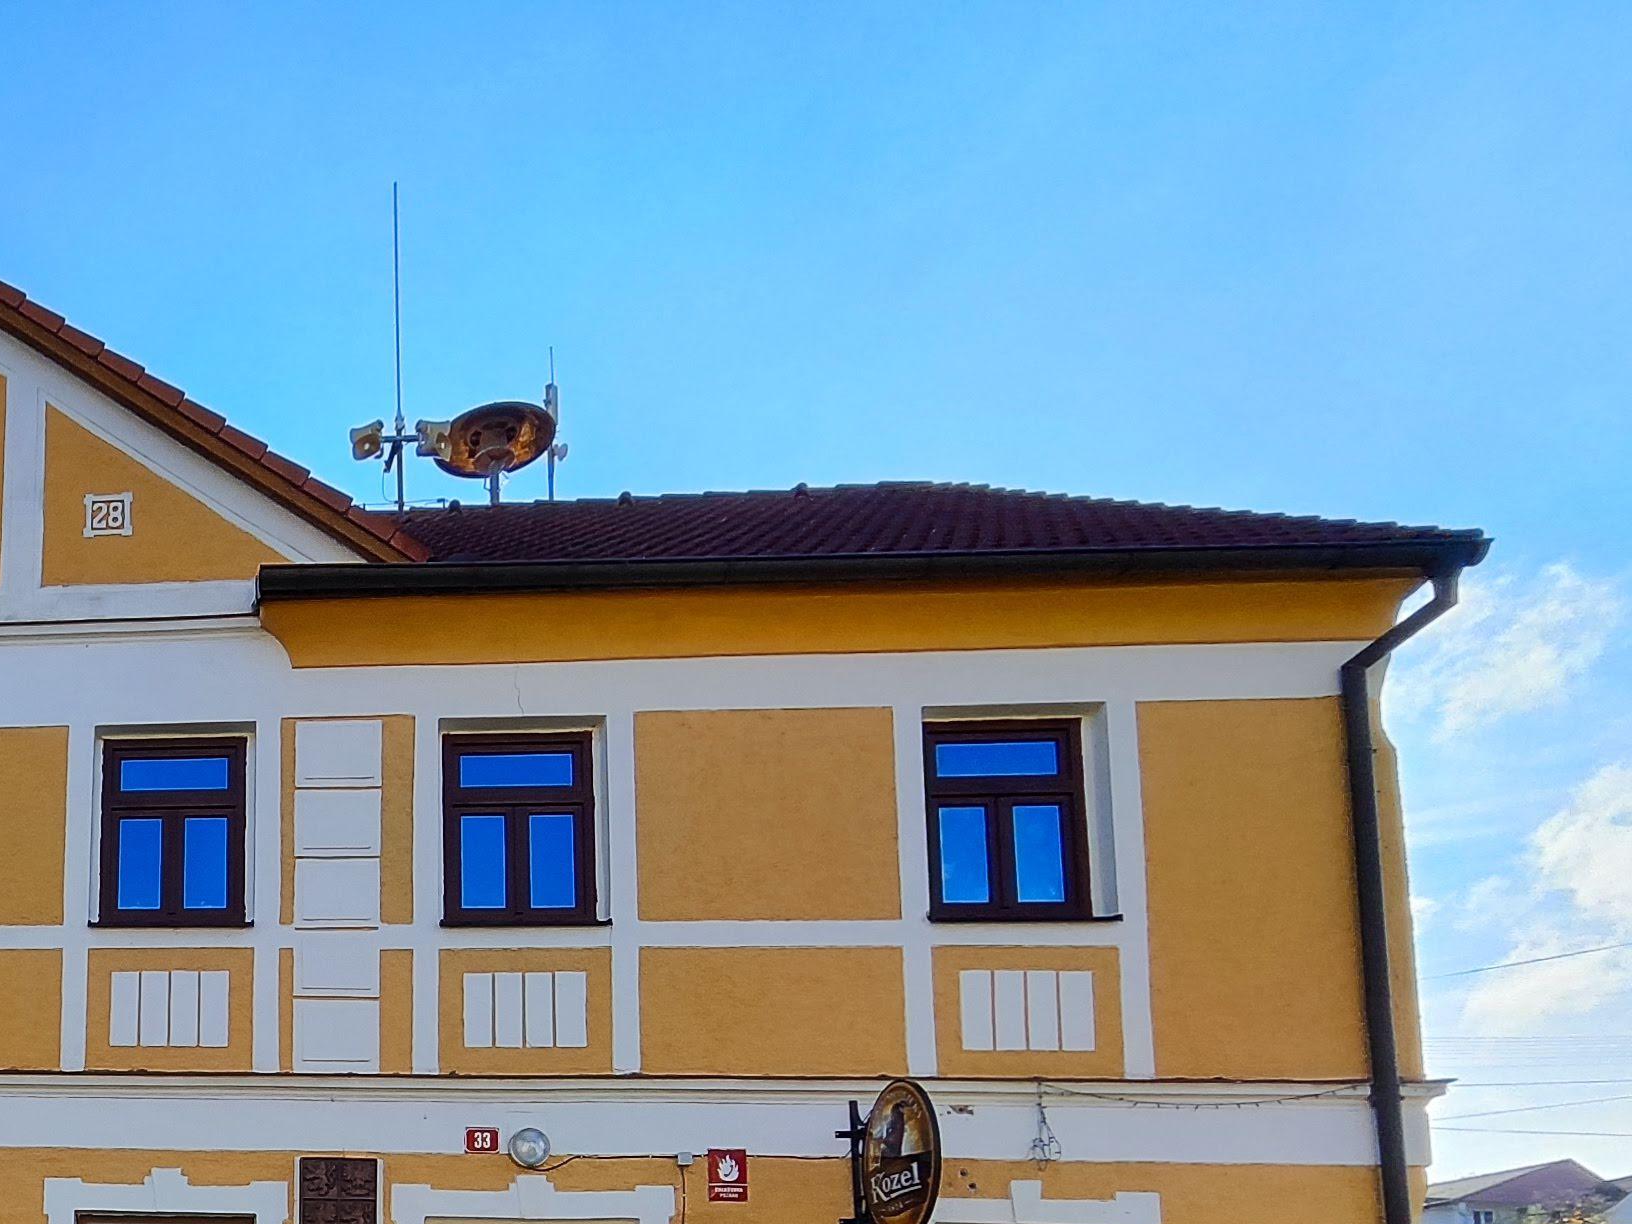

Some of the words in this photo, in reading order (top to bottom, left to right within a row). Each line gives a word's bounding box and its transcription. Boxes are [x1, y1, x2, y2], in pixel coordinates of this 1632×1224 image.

[92, 502, 123, 529] 28
[473, 1131, 491, 1149] 33
[870, 1161, 922, 1204] Kozel
